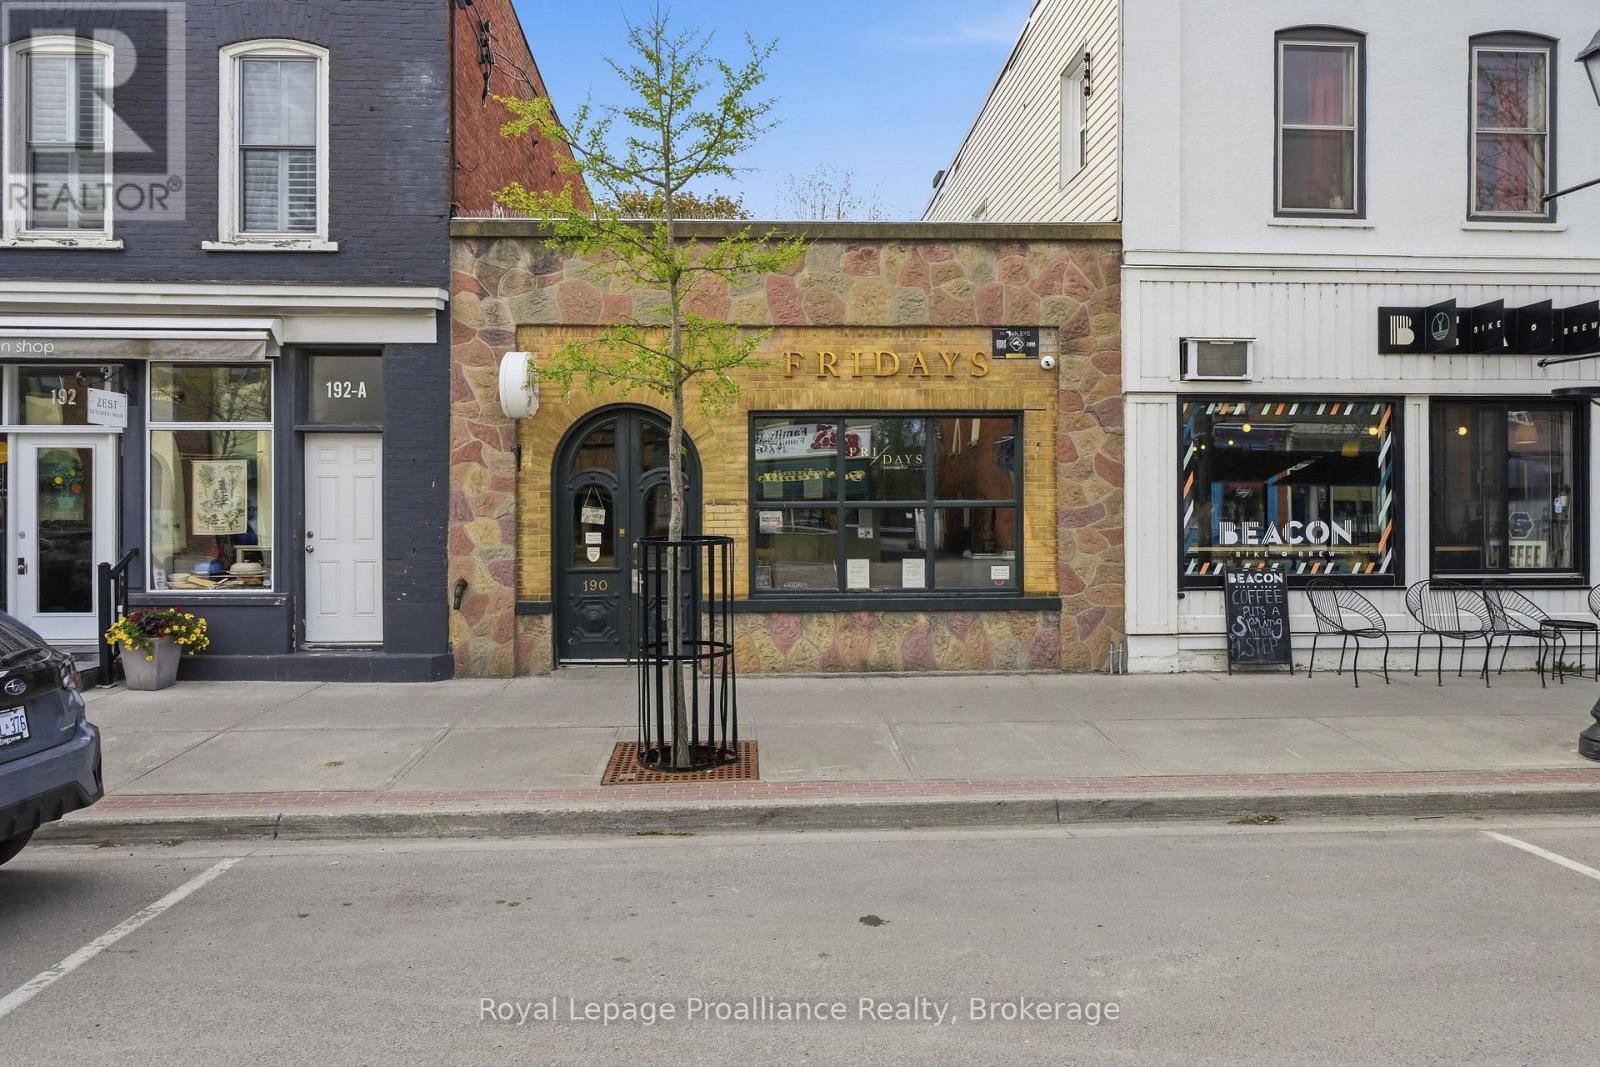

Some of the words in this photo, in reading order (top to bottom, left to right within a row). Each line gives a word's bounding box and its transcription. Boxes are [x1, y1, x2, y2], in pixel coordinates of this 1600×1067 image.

[15, 340, 54, 356] shop
[784, 351, 990, 378] FRIDAYS
[51, 388, 77, 406] 192
[326, 381, 367, 399] 192-A
[96, 397, 118, 409] ZEST
[882, 454, 923, 465] DAYS
[1219, 520, 1352, 545] BEACON
[583, 579, 608, 592] 190
[1227, 573, 1284, 584] BEACON
[1232, 589, 1283, 605] COFFEE
[1242, 605, 1267, 617] PUTS
[1271, 606, 1281, 616] A
[1231, 615, 1283, 639] Spring
[1245, 637, 1278, 657] STEP
